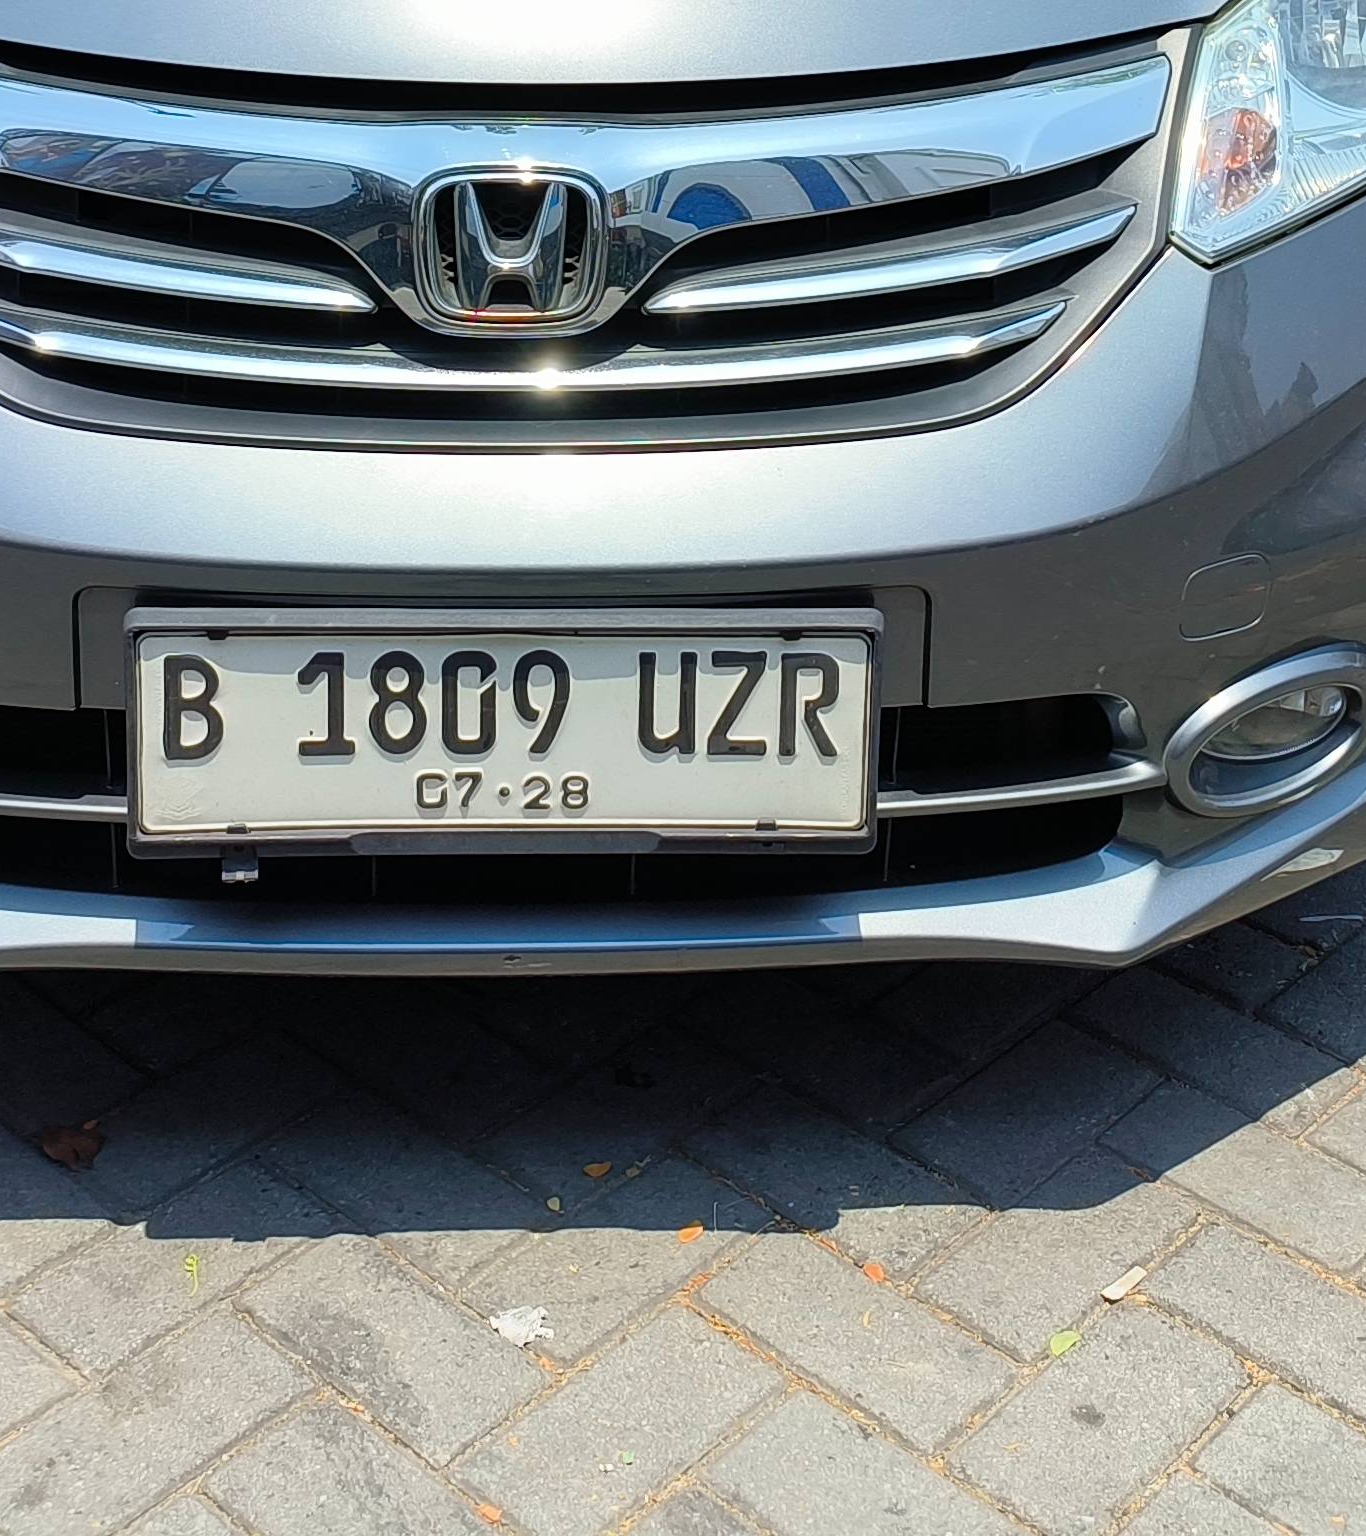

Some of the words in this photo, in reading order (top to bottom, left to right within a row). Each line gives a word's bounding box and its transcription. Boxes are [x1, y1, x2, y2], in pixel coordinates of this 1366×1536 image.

[163, 654, 224, 760] B
[296, 649, 571, 756] 1809
[637, 650, 840, 757] UZR
